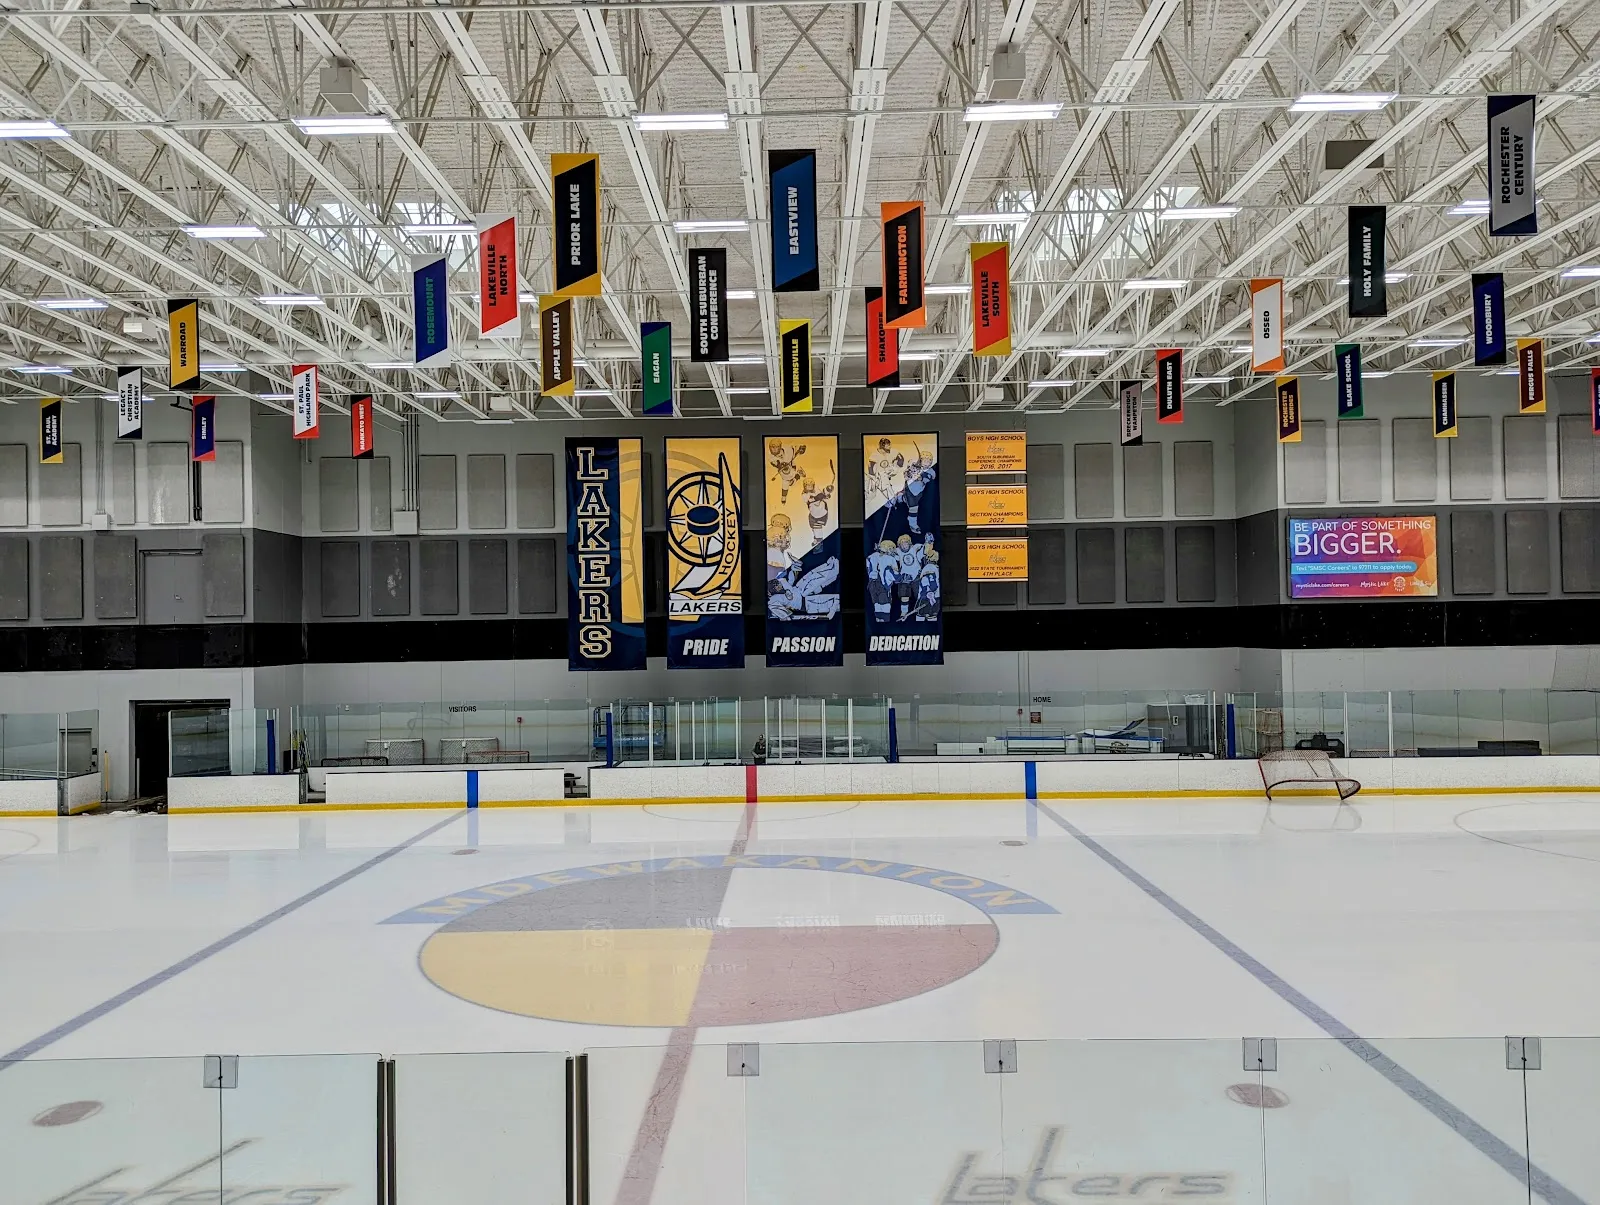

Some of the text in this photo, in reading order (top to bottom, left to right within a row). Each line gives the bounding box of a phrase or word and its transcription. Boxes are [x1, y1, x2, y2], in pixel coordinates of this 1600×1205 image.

[1501, 126, 1510, 204] ROCHESTER
[1514, 134, 1524, 196] CENTURY
[570, 184, 580, 266] PRIOR LAKE
[788, 186, 799, 255] EASTVIEW
[500, 254, 508, 296] NORTH
[898, 225, 907, 305] FARMINGTON
[1363, 225, 1372, 297] HOLY FAMILY
[698, 256, 709, 354] SOUTH SUBURBAN
[709, 269, 718, 340] CONFERENCE
[981, 270, 990, 327] LAKEVILLE
[552, 311, 561, 380] APPLE VALLEY
[577, 447, 611, 658] LAKERS
[719, 508, 736, 576] HOCKEY
[1294, 520, 1431, 531] BE PART OF SOMETHING
[1294, 532, 1401, 555] BIGGER.
[669, 601, 741, 613] LAKERS
[683, 639, 729, 656] PRIDE
[772, 636, 836, 653] PASSION
[869, 635, 940, 651] DEDICATION
[416, 854, 1038, 916] MDEWAKANTON
